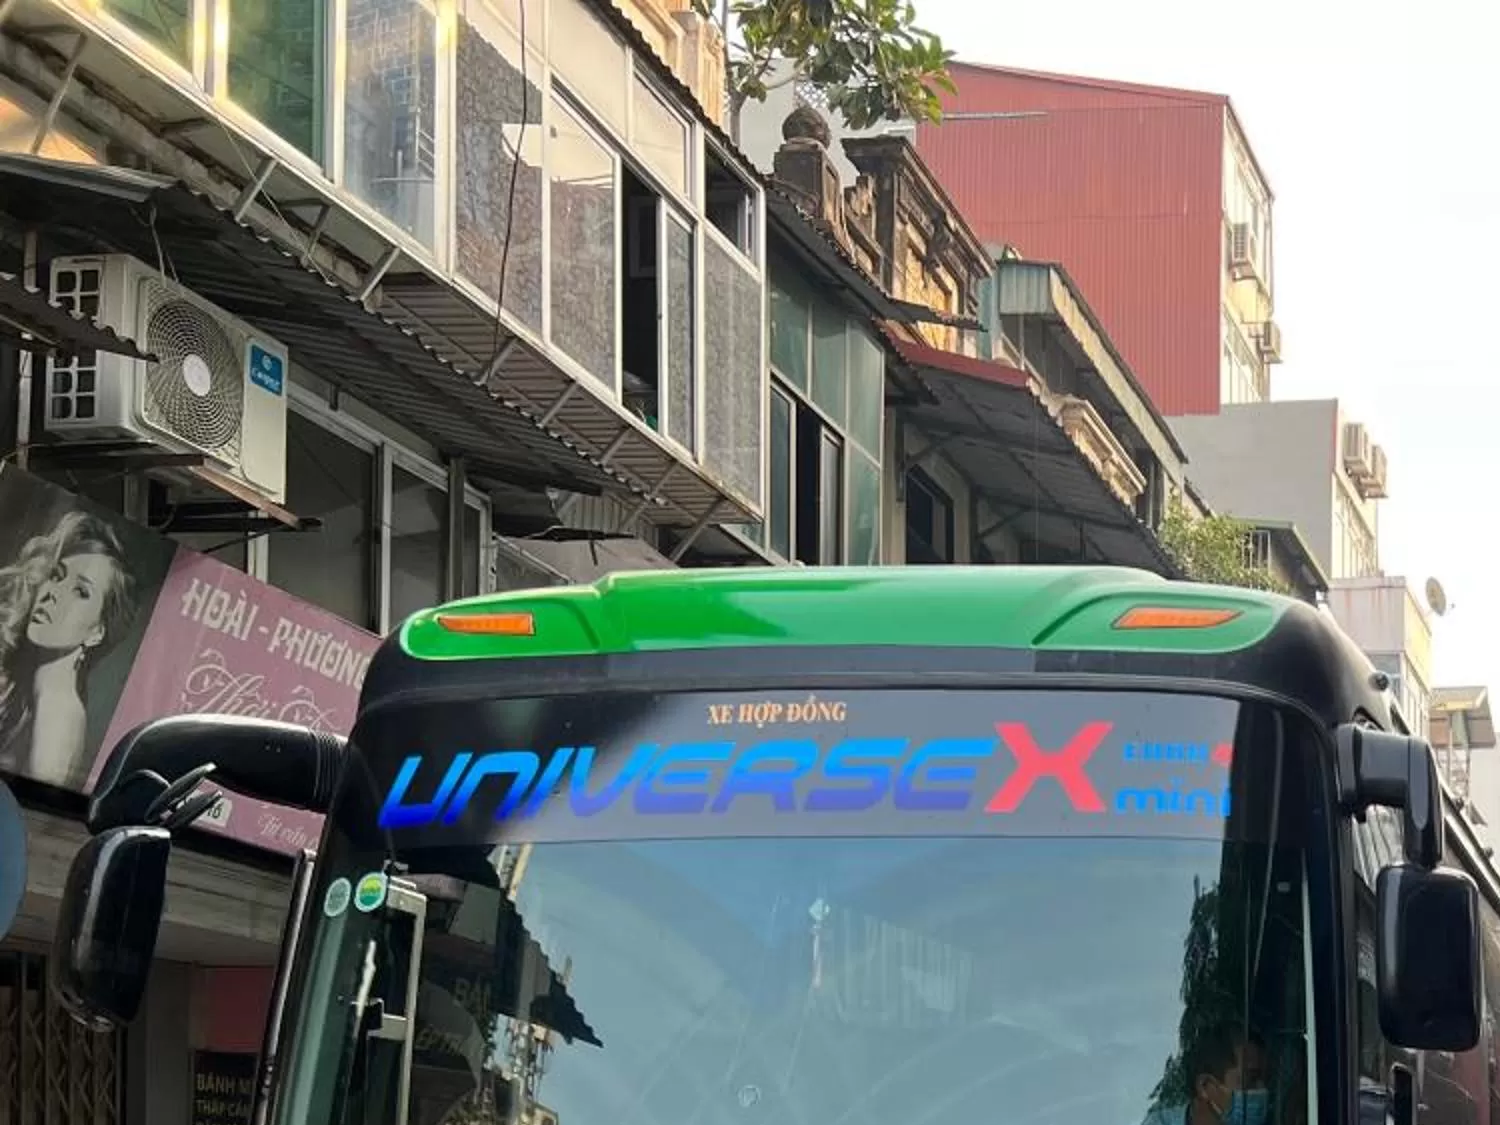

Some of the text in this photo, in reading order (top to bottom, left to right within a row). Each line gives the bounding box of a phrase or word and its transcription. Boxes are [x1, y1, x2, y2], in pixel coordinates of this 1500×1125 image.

[706, 703, 734, 725] XE
[737, 700, 783, 729] HỢP
[1114, 775, 1232, 818] mini
